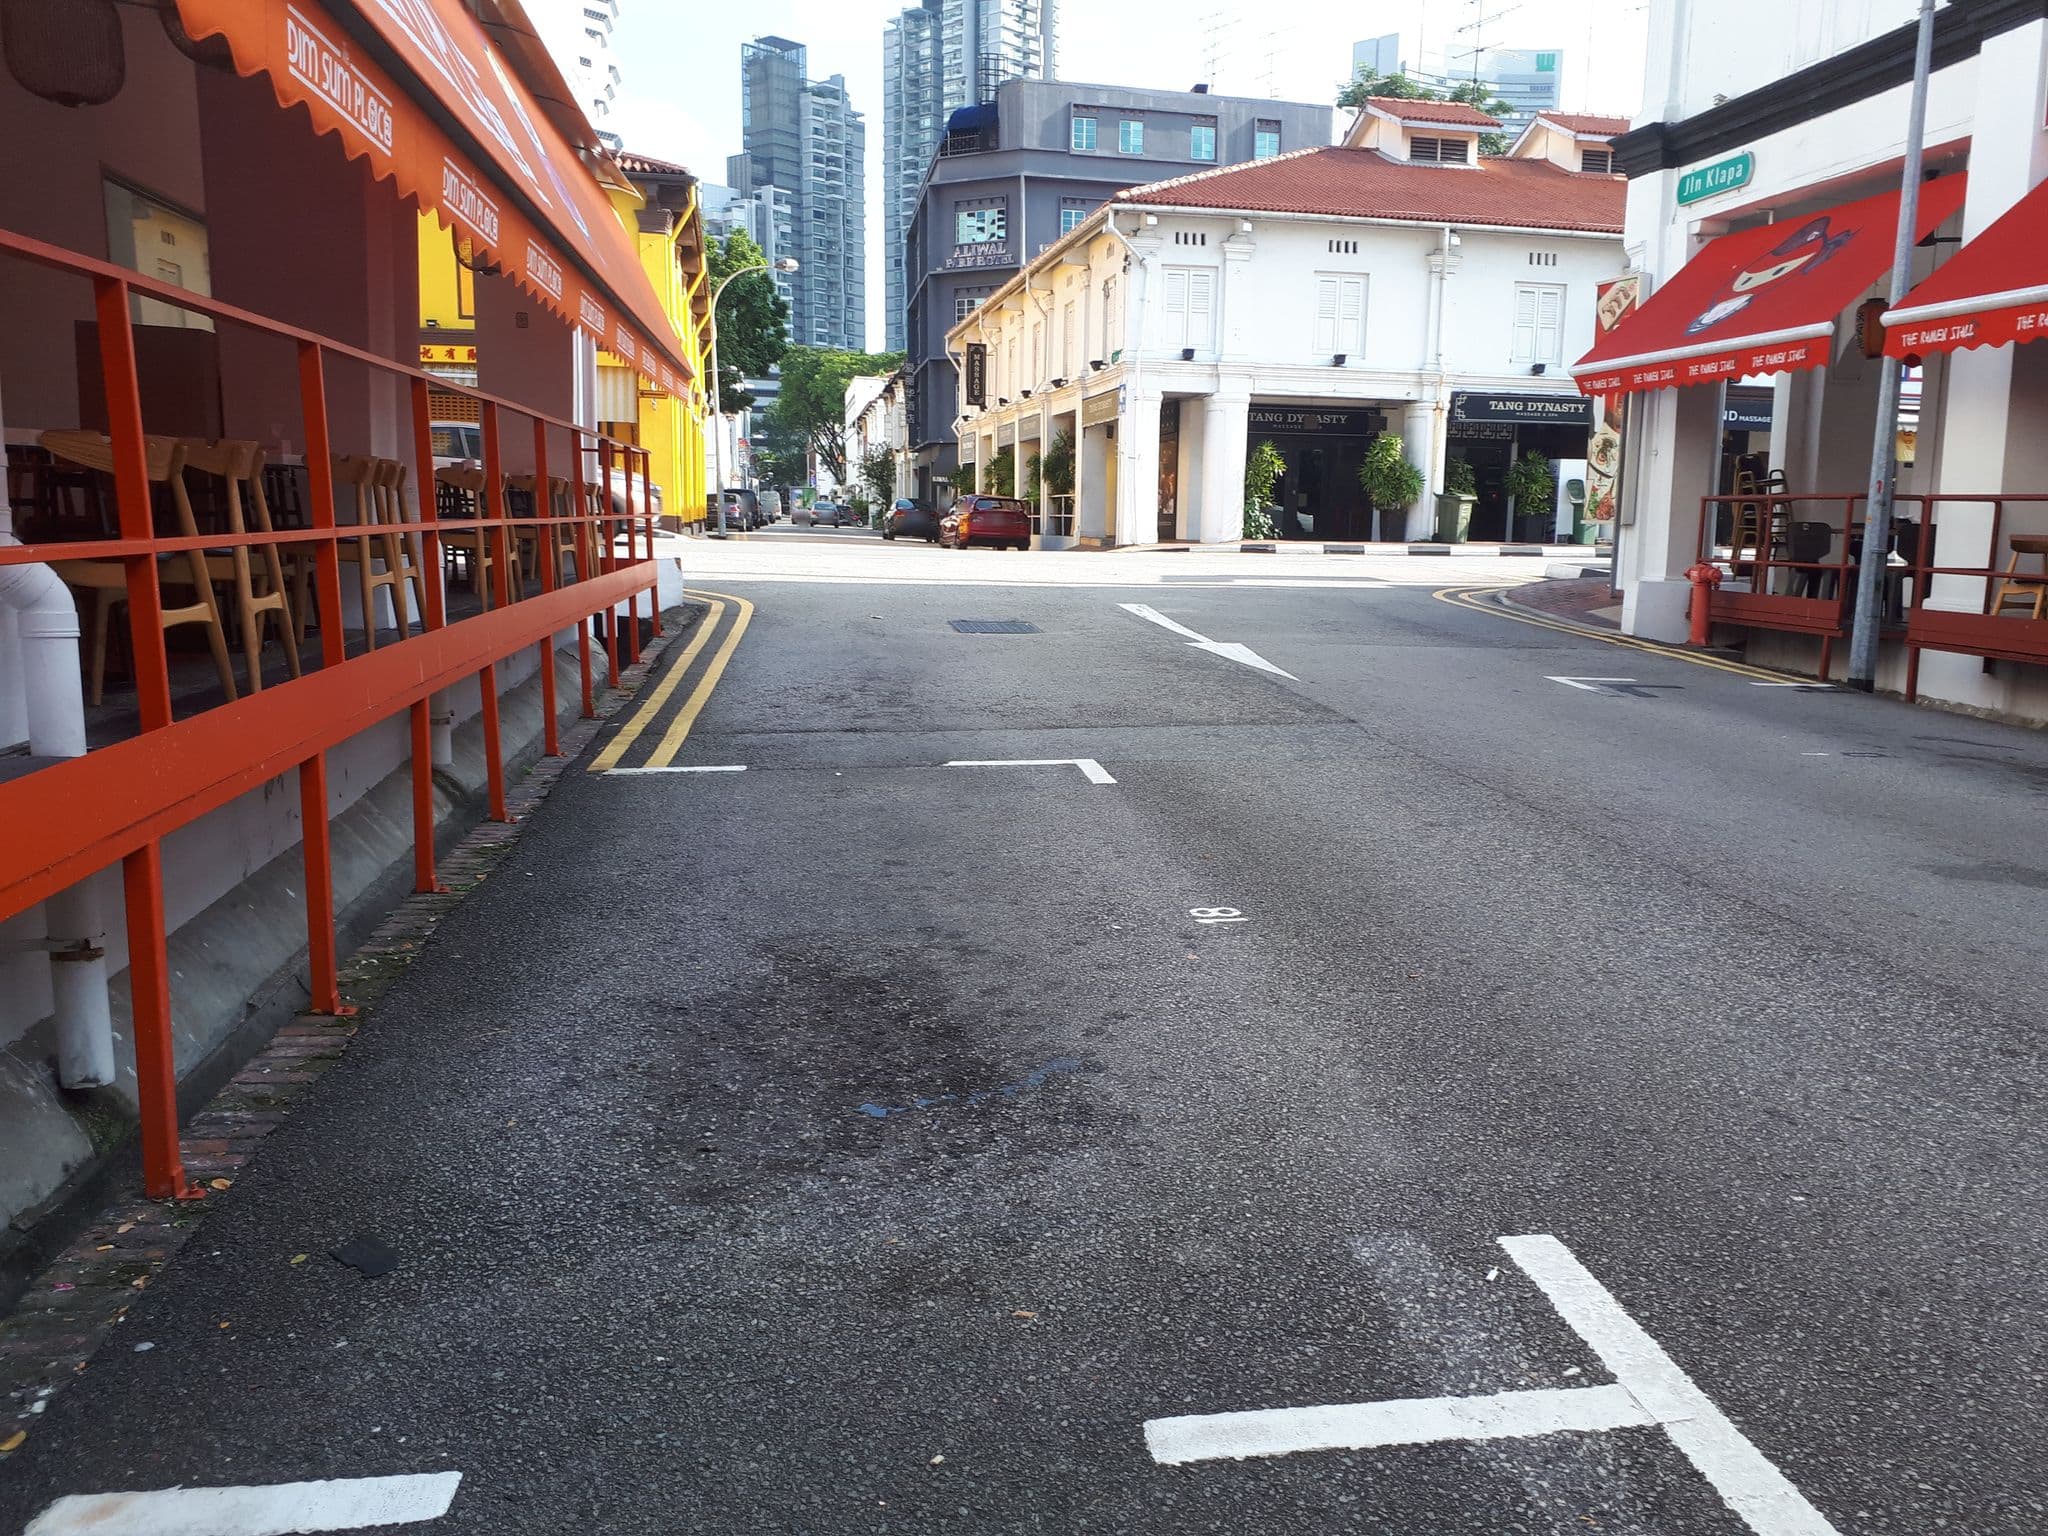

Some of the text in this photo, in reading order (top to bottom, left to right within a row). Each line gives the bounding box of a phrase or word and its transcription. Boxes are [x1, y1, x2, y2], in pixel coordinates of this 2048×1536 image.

[1683, 164, 1744, 196] Jln Klapa
[953, 242, 1006, 258] ALIWAL
[2016, 314, 2037, 331] THE
[1901, 324, 1975, 347] THE RAMEN STALL
[973, 353, 981, 396] MASSAGE
[1489, 400, 1586, 413] TANG DYNASTY
[1249, 412, 1348, 424] TANG DYASTY
